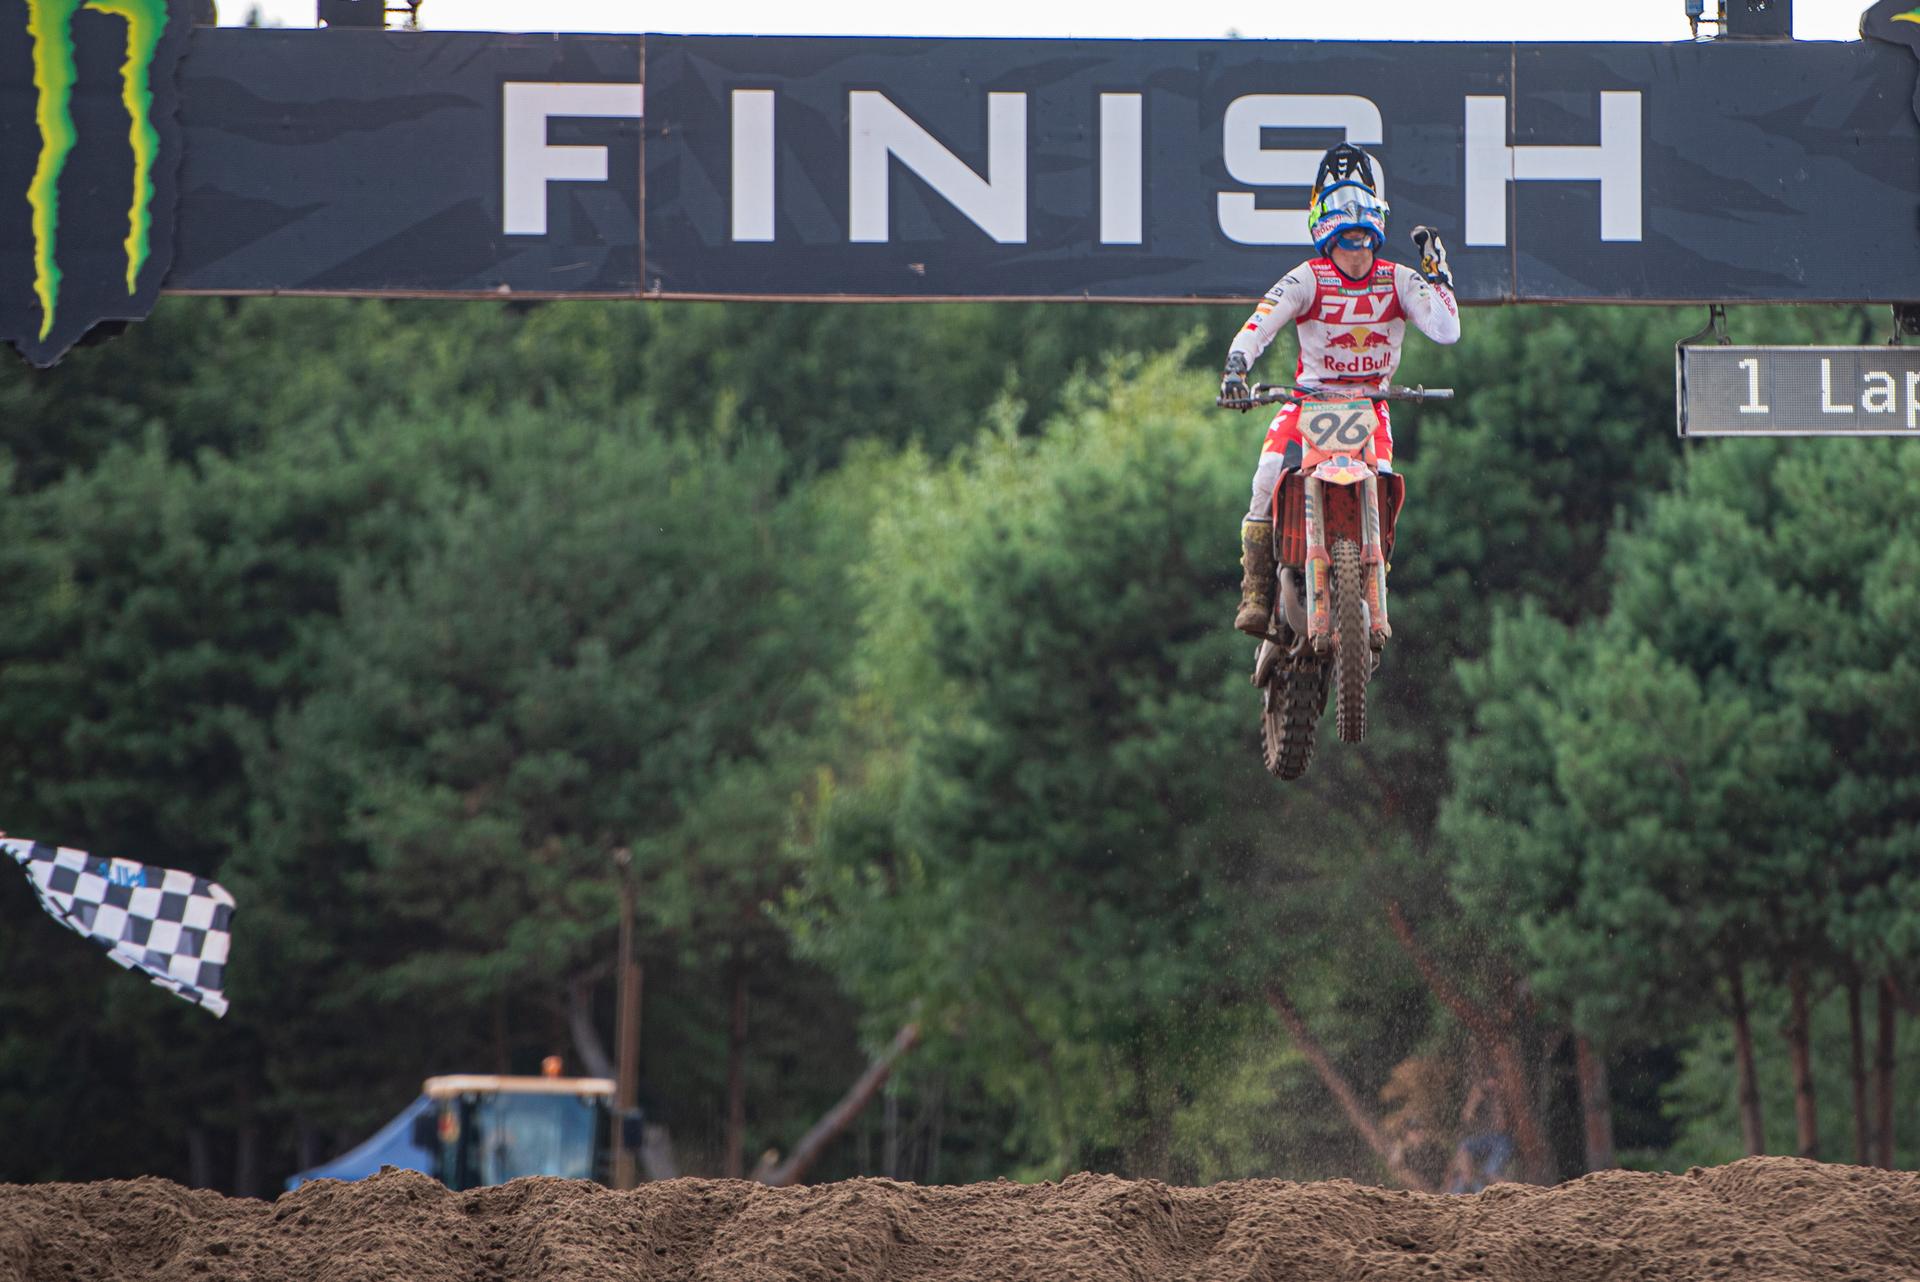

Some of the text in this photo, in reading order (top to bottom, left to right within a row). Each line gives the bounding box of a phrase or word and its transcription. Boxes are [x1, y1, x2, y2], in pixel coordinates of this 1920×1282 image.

[502, 82, 1642, 247] FINISH
[1318, 293, 1394, 323] FLY
[1323, 352, 1391, 372] Red Bull
[1738, 358, 1769, 414] 1
[1309, 411, 1370, 446] 96
